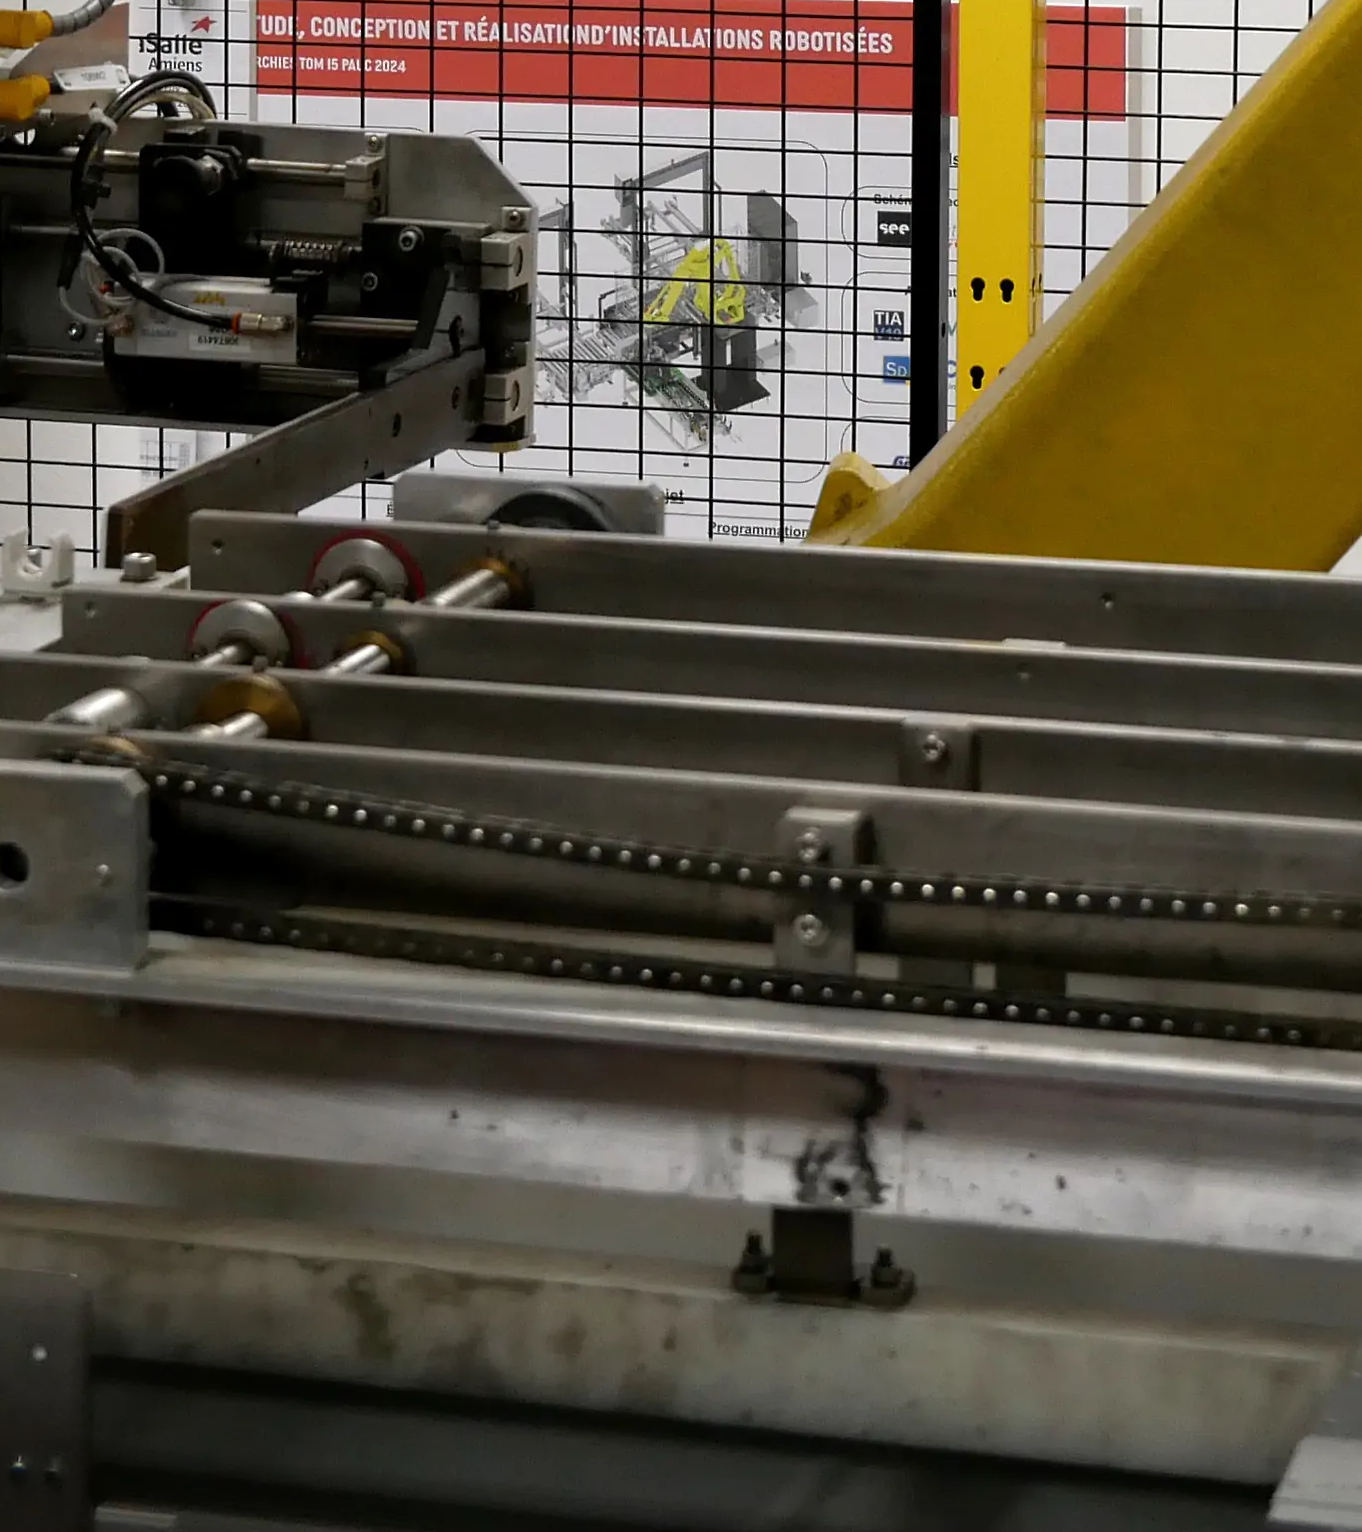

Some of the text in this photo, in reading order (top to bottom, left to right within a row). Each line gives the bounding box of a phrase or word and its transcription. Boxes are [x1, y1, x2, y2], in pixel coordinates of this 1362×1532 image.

[310, 18, 431, 41] CONCEPTION
[438, 19, 457, 42] ET
[769, 25, 893, 54] ROBOTISÉES
[148, 56, 203, 73] Amiens
[299, 56, 324, 71] TOM
[375, 59, 406, 73] 2024
[879, 223, 910, 235] see
[875, 311, 903, 326] TIA
